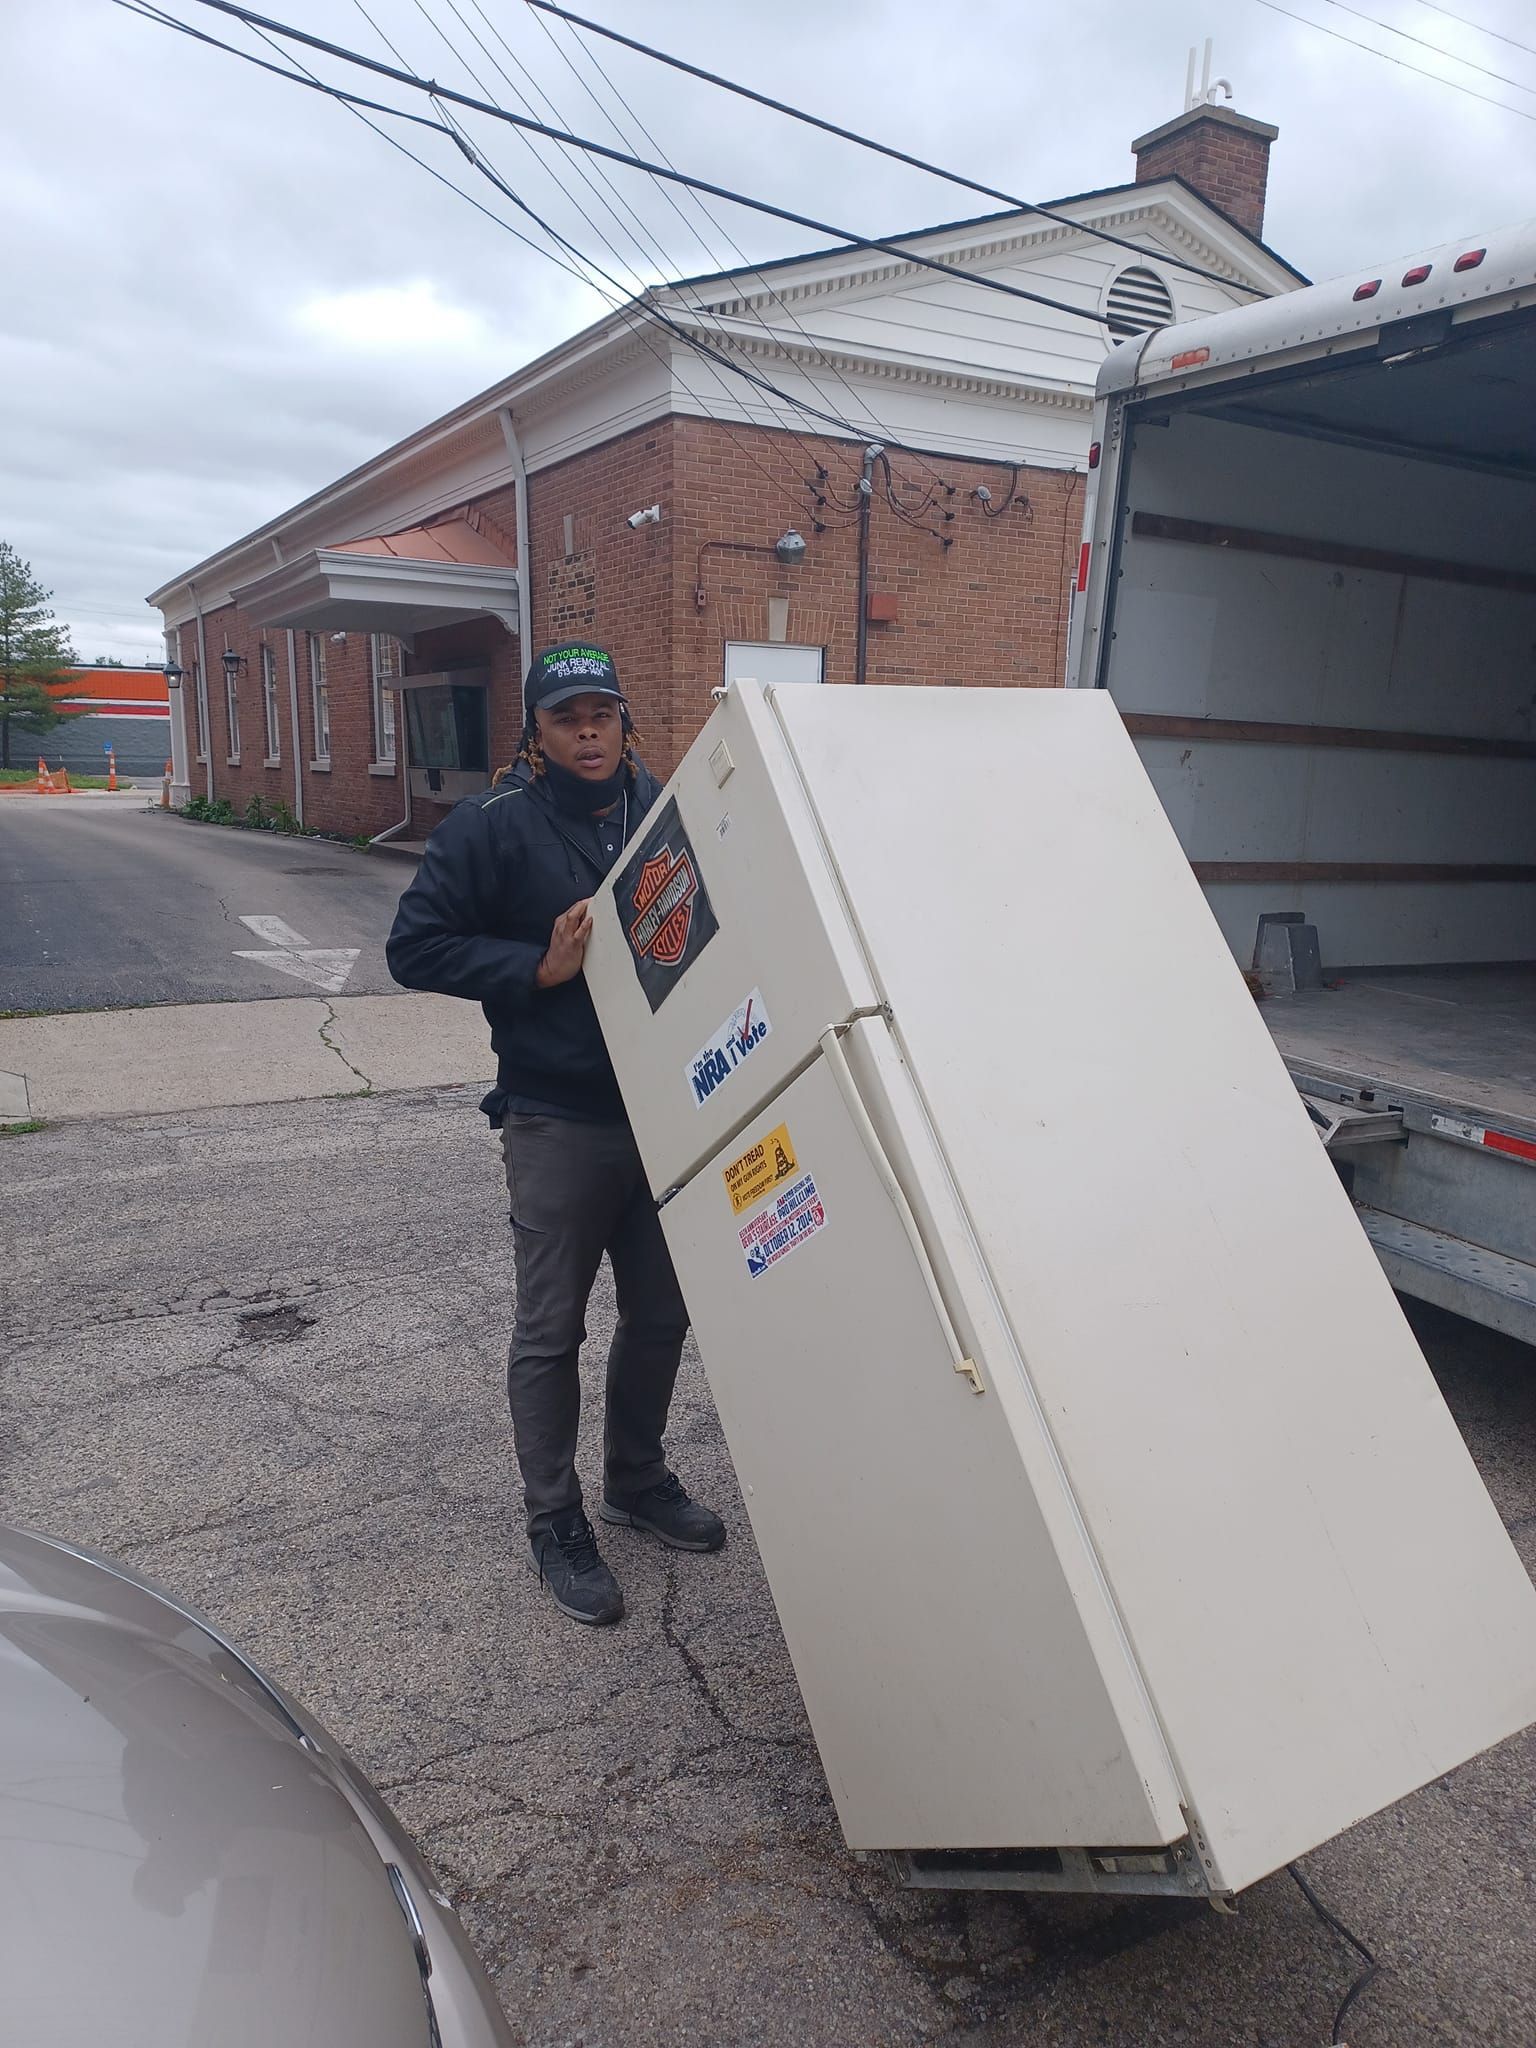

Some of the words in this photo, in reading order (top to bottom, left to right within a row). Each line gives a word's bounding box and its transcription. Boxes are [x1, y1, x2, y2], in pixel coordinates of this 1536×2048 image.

[543, 653, 557, 665] NOT
[558, 648, 580, 659] YOUR
[580, 648, 609, 663] AVERAGE
[547, 659, 568, 673] JUNK
[569, 657, 610, 671] REMOVAL
[639, 863, 668, 906] MOTOR
[636, 866, 692, 947] HARLEY-DAVIDSON
[656, 911, 686, 954] CYCLES
[692, 1048, 731, 1103] NRA
[735, 1021, 767, 1057] Vote
[703, 1049, 713, 1062] the
[725, 1159, 744, 1182] DON'T
[743, 1144, 764, 1167] TREAD
[743, 1171, 752, 1182] GUN
[751, 1160, 767, 1176] RIGHTS
[777, 1203, 790, 1220] PRO
[787, 1182, 816, 1211] HILLCLIMB
[763, 1228, 790, 1257] OCTOBER
[796, 1209, 813, 1231] 2014
